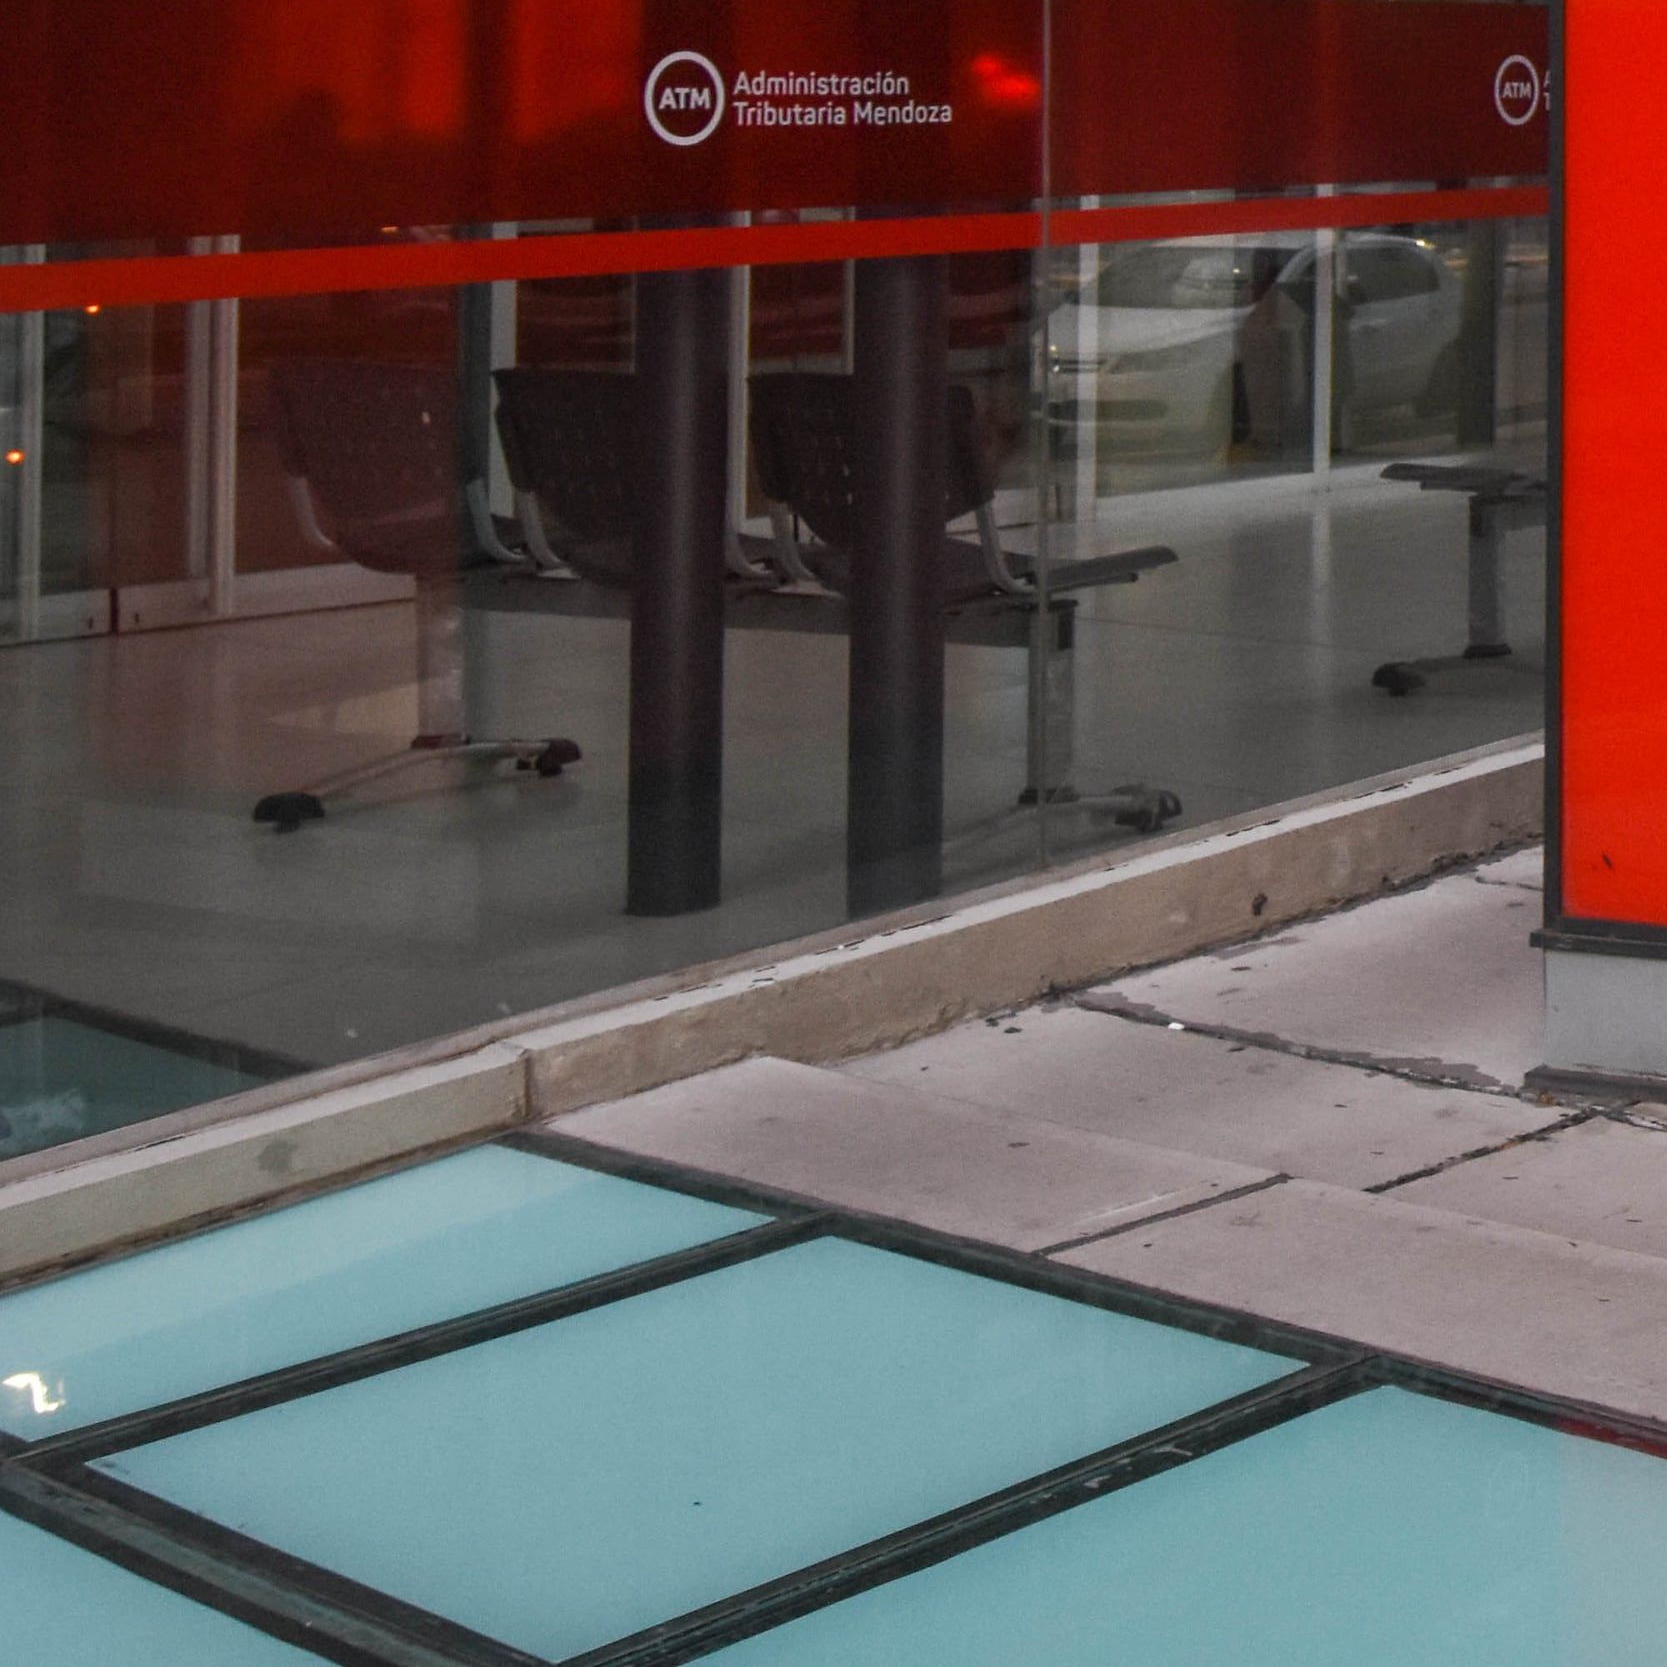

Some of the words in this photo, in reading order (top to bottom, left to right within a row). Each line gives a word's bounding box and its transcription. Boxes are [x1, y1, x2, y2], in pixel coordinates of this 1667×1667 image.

[733, 70, 910, 95] Administración
[1502, 81, 1532, 99] ATM
[658, 87, 712, 109] ATM
[733, 101, 847, 126] Tributaria
[853, 100, 952, 126] Mendoza
